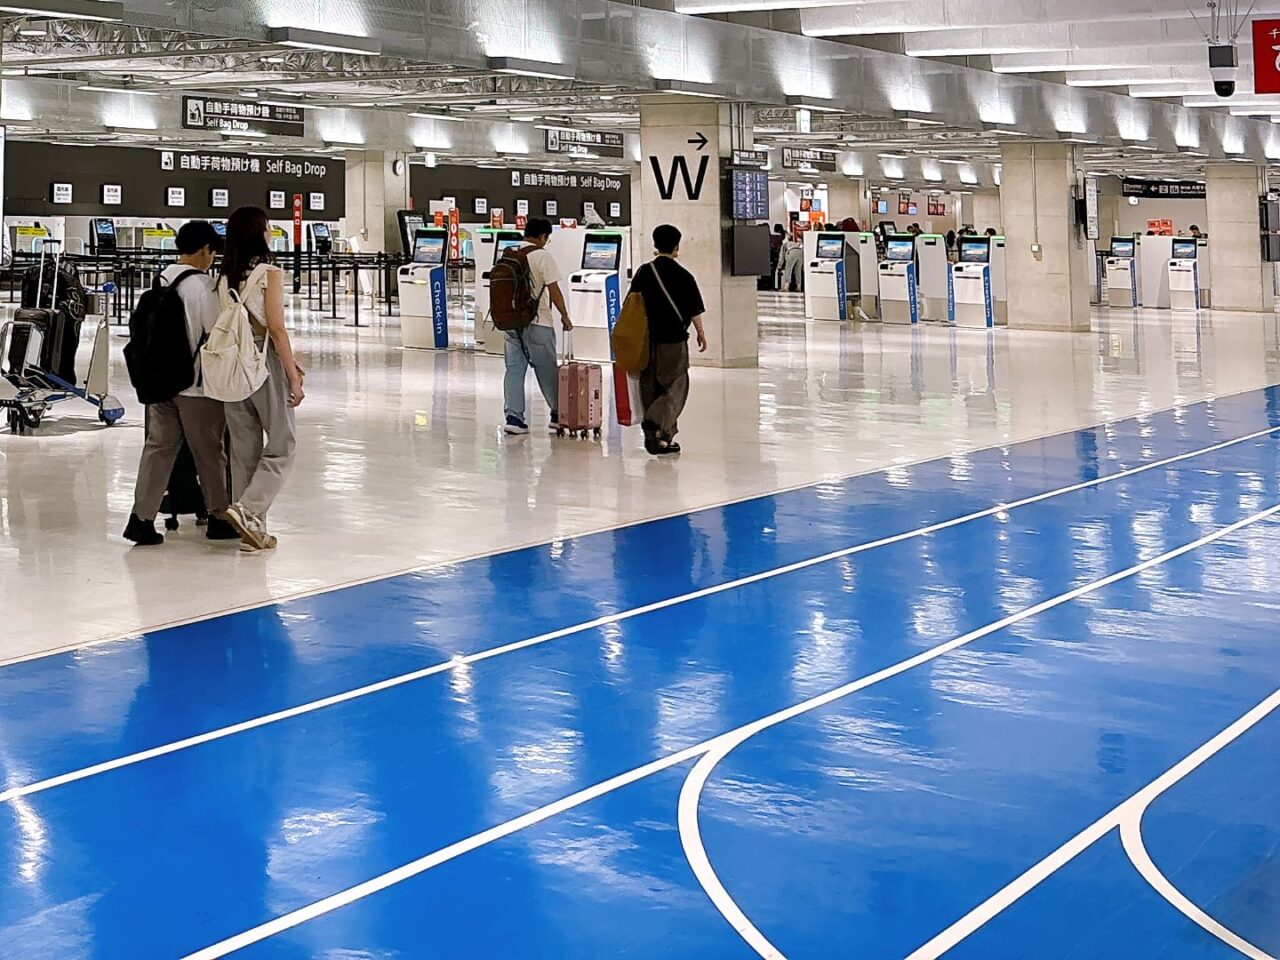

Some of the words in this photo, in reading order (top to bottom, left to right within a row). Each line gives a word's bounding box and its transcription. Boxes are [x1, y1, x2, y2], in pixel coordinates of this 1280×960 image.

[206, 119, 219, 127] Self
[219, 119, 232, 130] Bag
[232, 120, 249, 131] Drop
[180, 154, 261, 173] 自動手荷物預け機
[266, 160, 284, 173] Self
[285, 164, 303, 178] Bag
[304, 162, 327, 179] Drop
[649, 155, 710, 200] W
[580, 177, 593, 188] Self
[593, 178, 606, 191] Bag
[606, 178, 621, 191] Drop
[432, 281, 442, 335] Check-in
